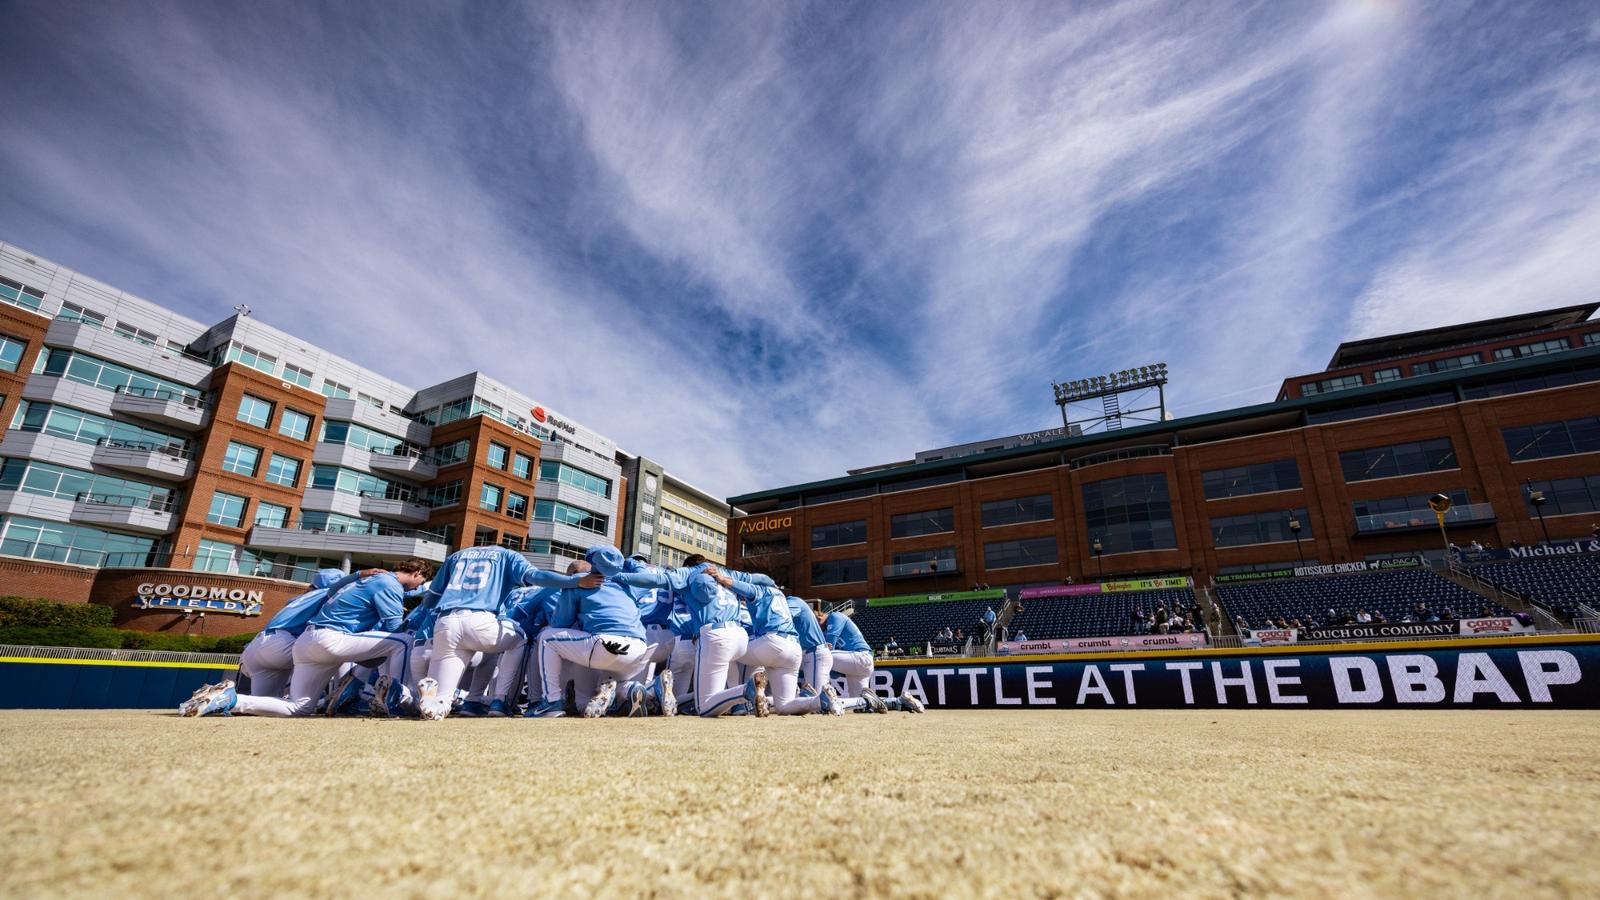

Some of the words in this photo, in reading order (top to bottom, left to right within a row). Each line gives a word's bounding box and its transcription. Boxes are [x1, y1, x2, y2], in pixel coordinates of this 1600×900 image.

[738, 516, 792, 534] Avalara
[1509, 542, 1582, 558] Michael
[1588, 540, 1600, 552] &
[447, 560, 492, 591] 19
[1273, 569, 1292, 577] BEST
[1294, 565, 1334, 577] ROTISSERIE
[1334, 561, 1367, 573] CHICKEN
[1381, 558, 1419, 567] ALPACA
[1165, 578, 1182, 586] TIME!
[137, 582, 264, 602] GOODMON
[159, 597, 237, 610] FIELD
[1256, 630, 1293, 638] COUCH
[1353, 626, 1379, 637] OIL
[1381, 623, 1454, 635] COMPANY
[1020, 641, 1052, 650] crumbl
[1078, 639, 1111, 648] crumbl
[1142, 636, 1179, 646] crumbl
[869, 666, 1057, 705] BATTLE
[1076, 663, 1145, 705] AT
[1165, 659, 1309, 704] THE
[1328, 650, 1582, 704] DBAP
